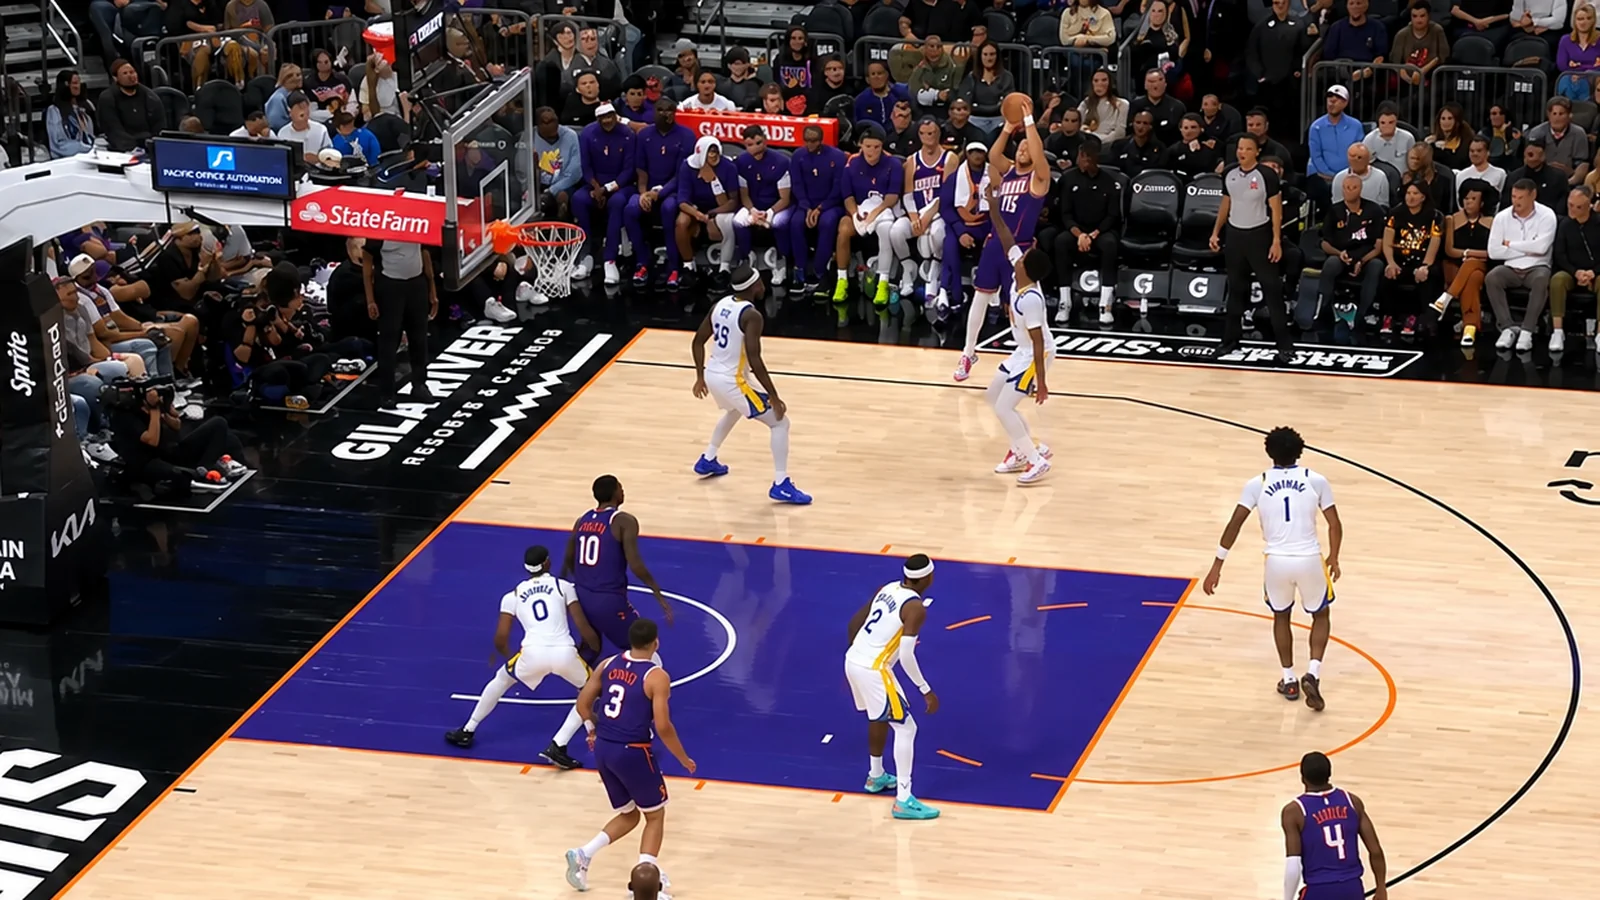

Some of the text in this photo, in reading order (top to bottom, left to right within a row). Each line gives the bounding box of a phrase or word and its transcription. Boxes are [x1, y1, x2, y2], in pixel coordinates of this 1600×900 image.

[699, 121, 795, 142] GATOADE
[1080, 270, 1099, 292] G
[1134, 273, 1154, 294] G
[1189, 277, 1209, 298] G
[7, 331, 37, 397] Sprite
[1284, 496, 1291, 522] 1
[0, 540, 24, 559] IN
[579, 535, 600, 566] 10
[532, 599, 549, 622] 0
[864, 608, 883, 635] 2
[604, 684, 626, 719] 3
[1323, 823, 1346, 860] 4
